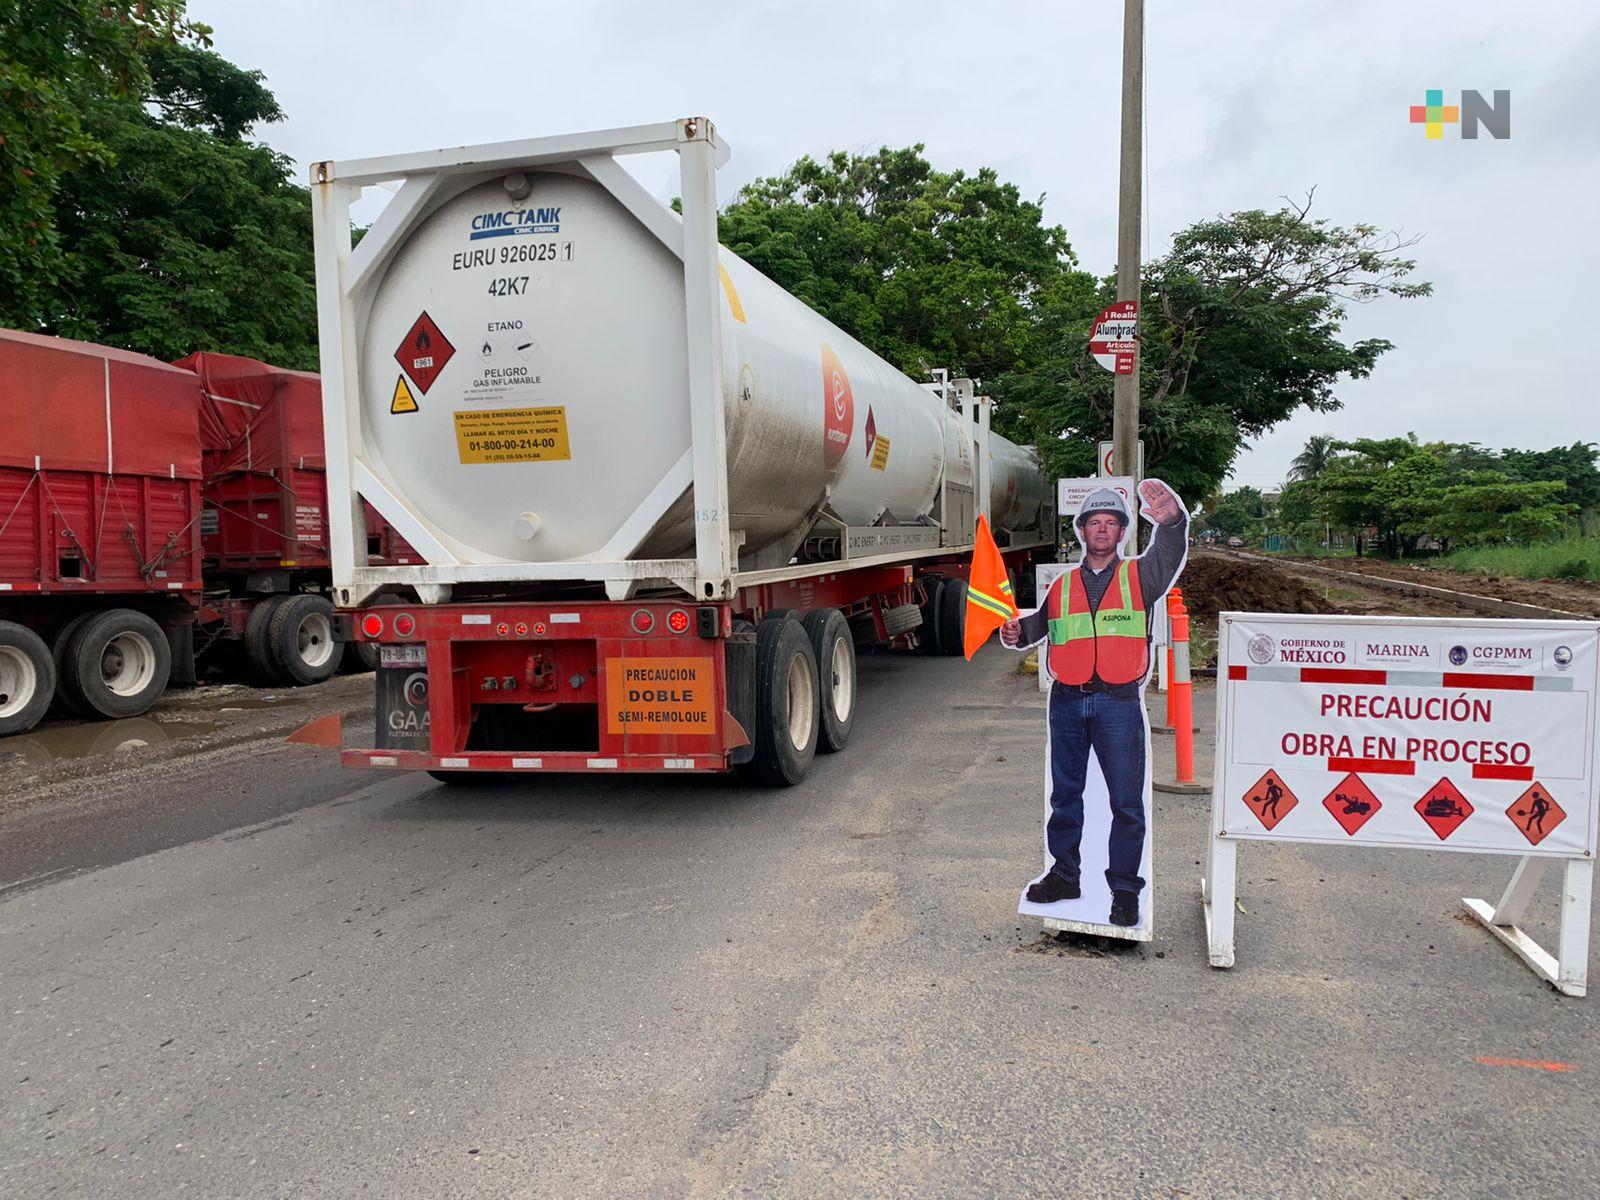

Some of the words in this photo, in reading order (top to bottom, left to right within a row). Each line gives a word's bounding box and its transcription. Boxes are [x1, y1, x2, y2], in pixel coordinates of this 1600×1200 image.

[453, 248, 496, 270] EURU
[501, 243, 556, 263] 926025
[488, 276, 530, 296] 42K7
[488, 320, 523, 332] ETANO
[415, 358, 431, 367] 1961
[484, 366, 528, 378] PELIGRO
[473, 379, 490, 387] GAS
[491, 376, 542, 386] INFLAMABLE
[469, 438, 555, 451] 01-800-00-214-00
[1102, 614, 1132, 622] ASIPONA
[1280, 638, 1331, 648] GOBIERNO
[1333, 640, 1346, 648] DE
[1280, 647, 1346, 664] MÉXICO
[1366, 643, 1430, 657] MARINA
[1472, 646, 1533, 660] CGPMM
[626, 669, 696, 681] PRECAUCION
[628, 689, 694, 703] DOBLE
[1320, 692, 1492, 723] PRECAUCIÓN
[618, 711, 708, 722] SEMI-REMOLQUE
[1281, 732, 1354, 758] OBRA
[1363, 736, 1397, 760] EN
[1406, 738, 1532, 766] PROCESO
